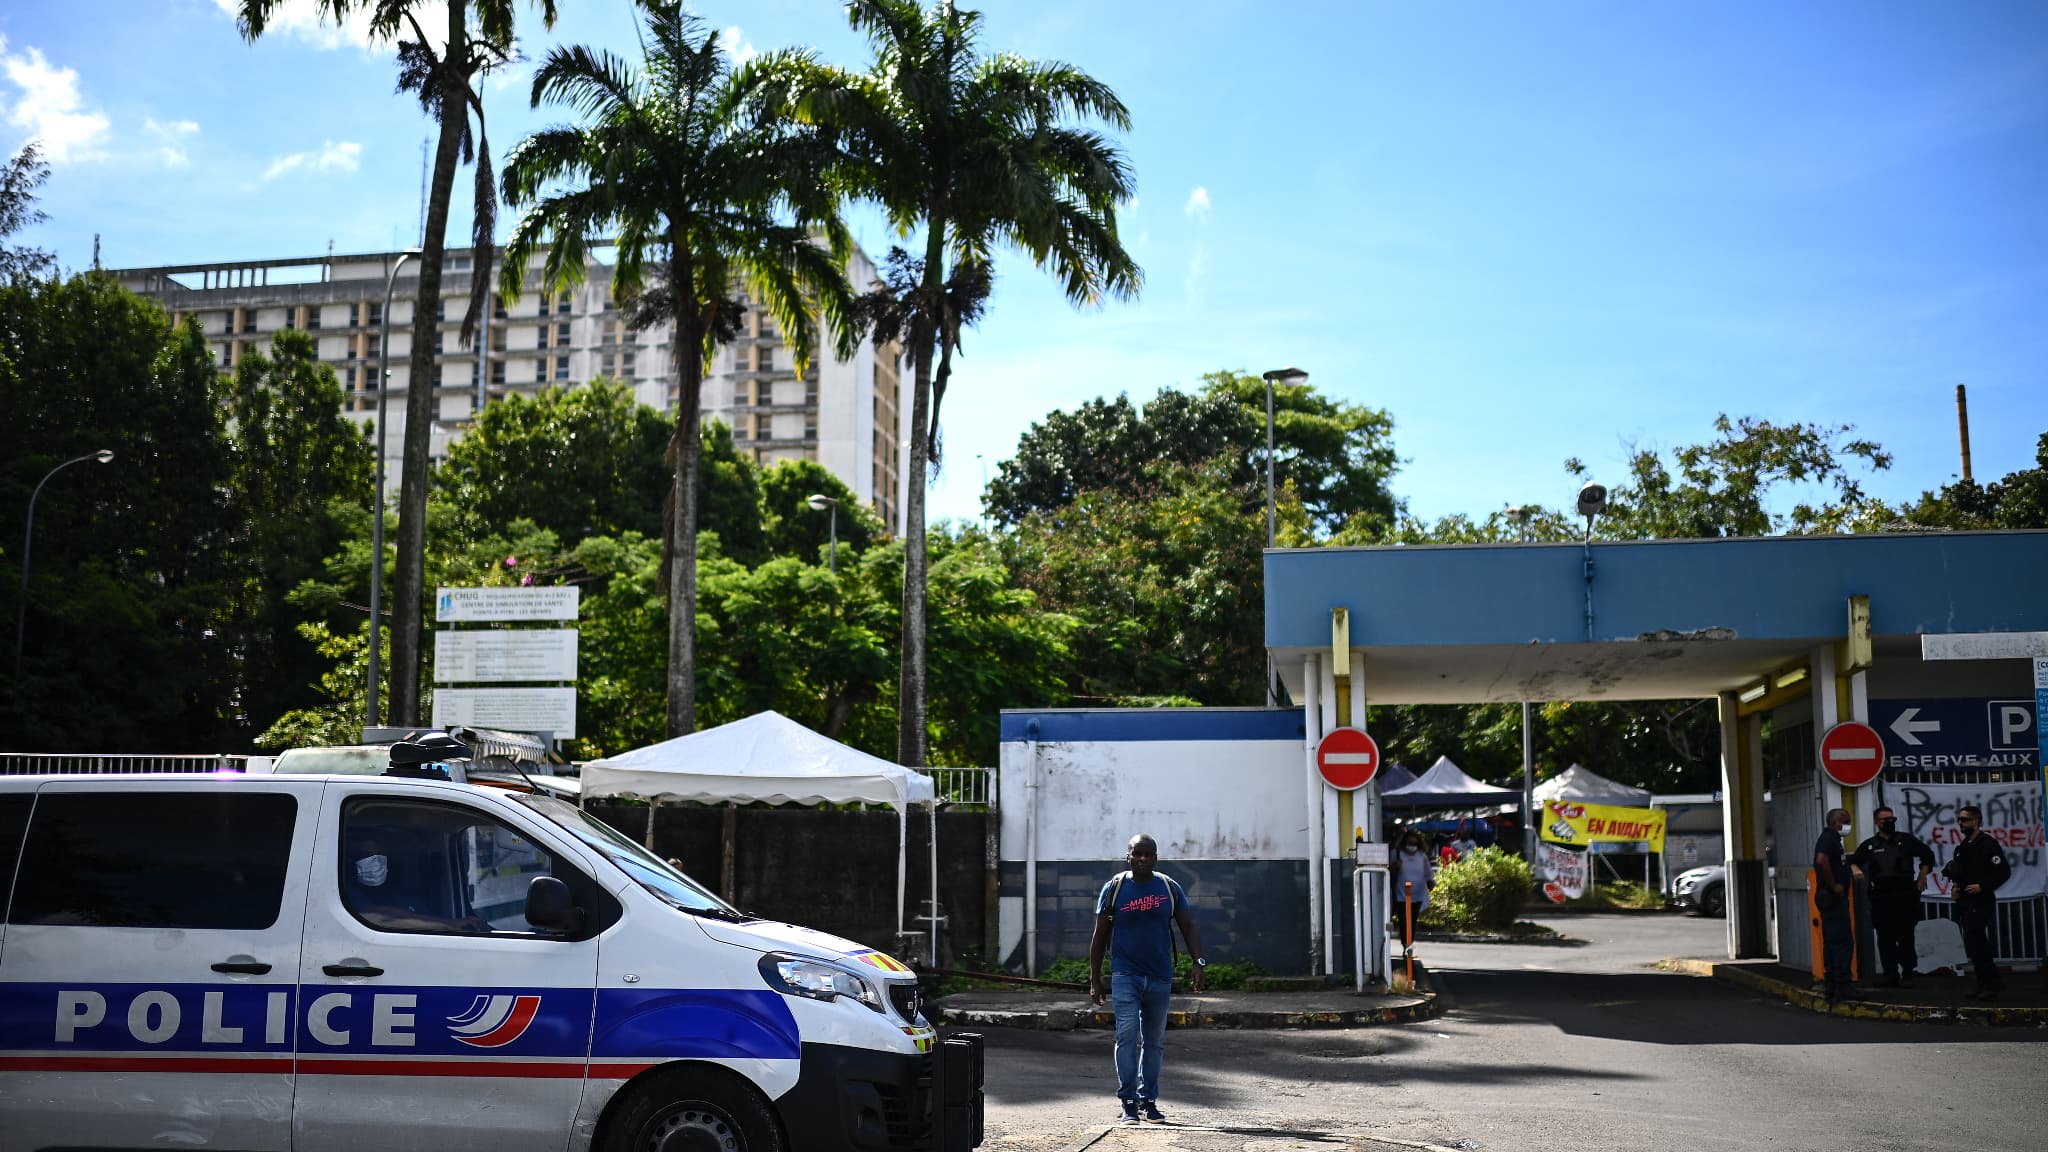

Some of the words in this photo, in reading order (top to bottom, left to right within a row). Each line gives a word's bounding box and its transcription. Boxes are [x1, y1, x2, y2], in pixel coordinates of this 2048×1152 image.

[2001, 706, 2032, 744] P
[1887, 754, 1977, 768] ESERVE
[1989, 753, 2033, 768] AUX
[1587, 817, 1607, 836] EN
[1606, 820, 1653, 839] AVANT
[1130, 894, 1154, 906] MADE
[54, 990, 418, 1047] POLICE
